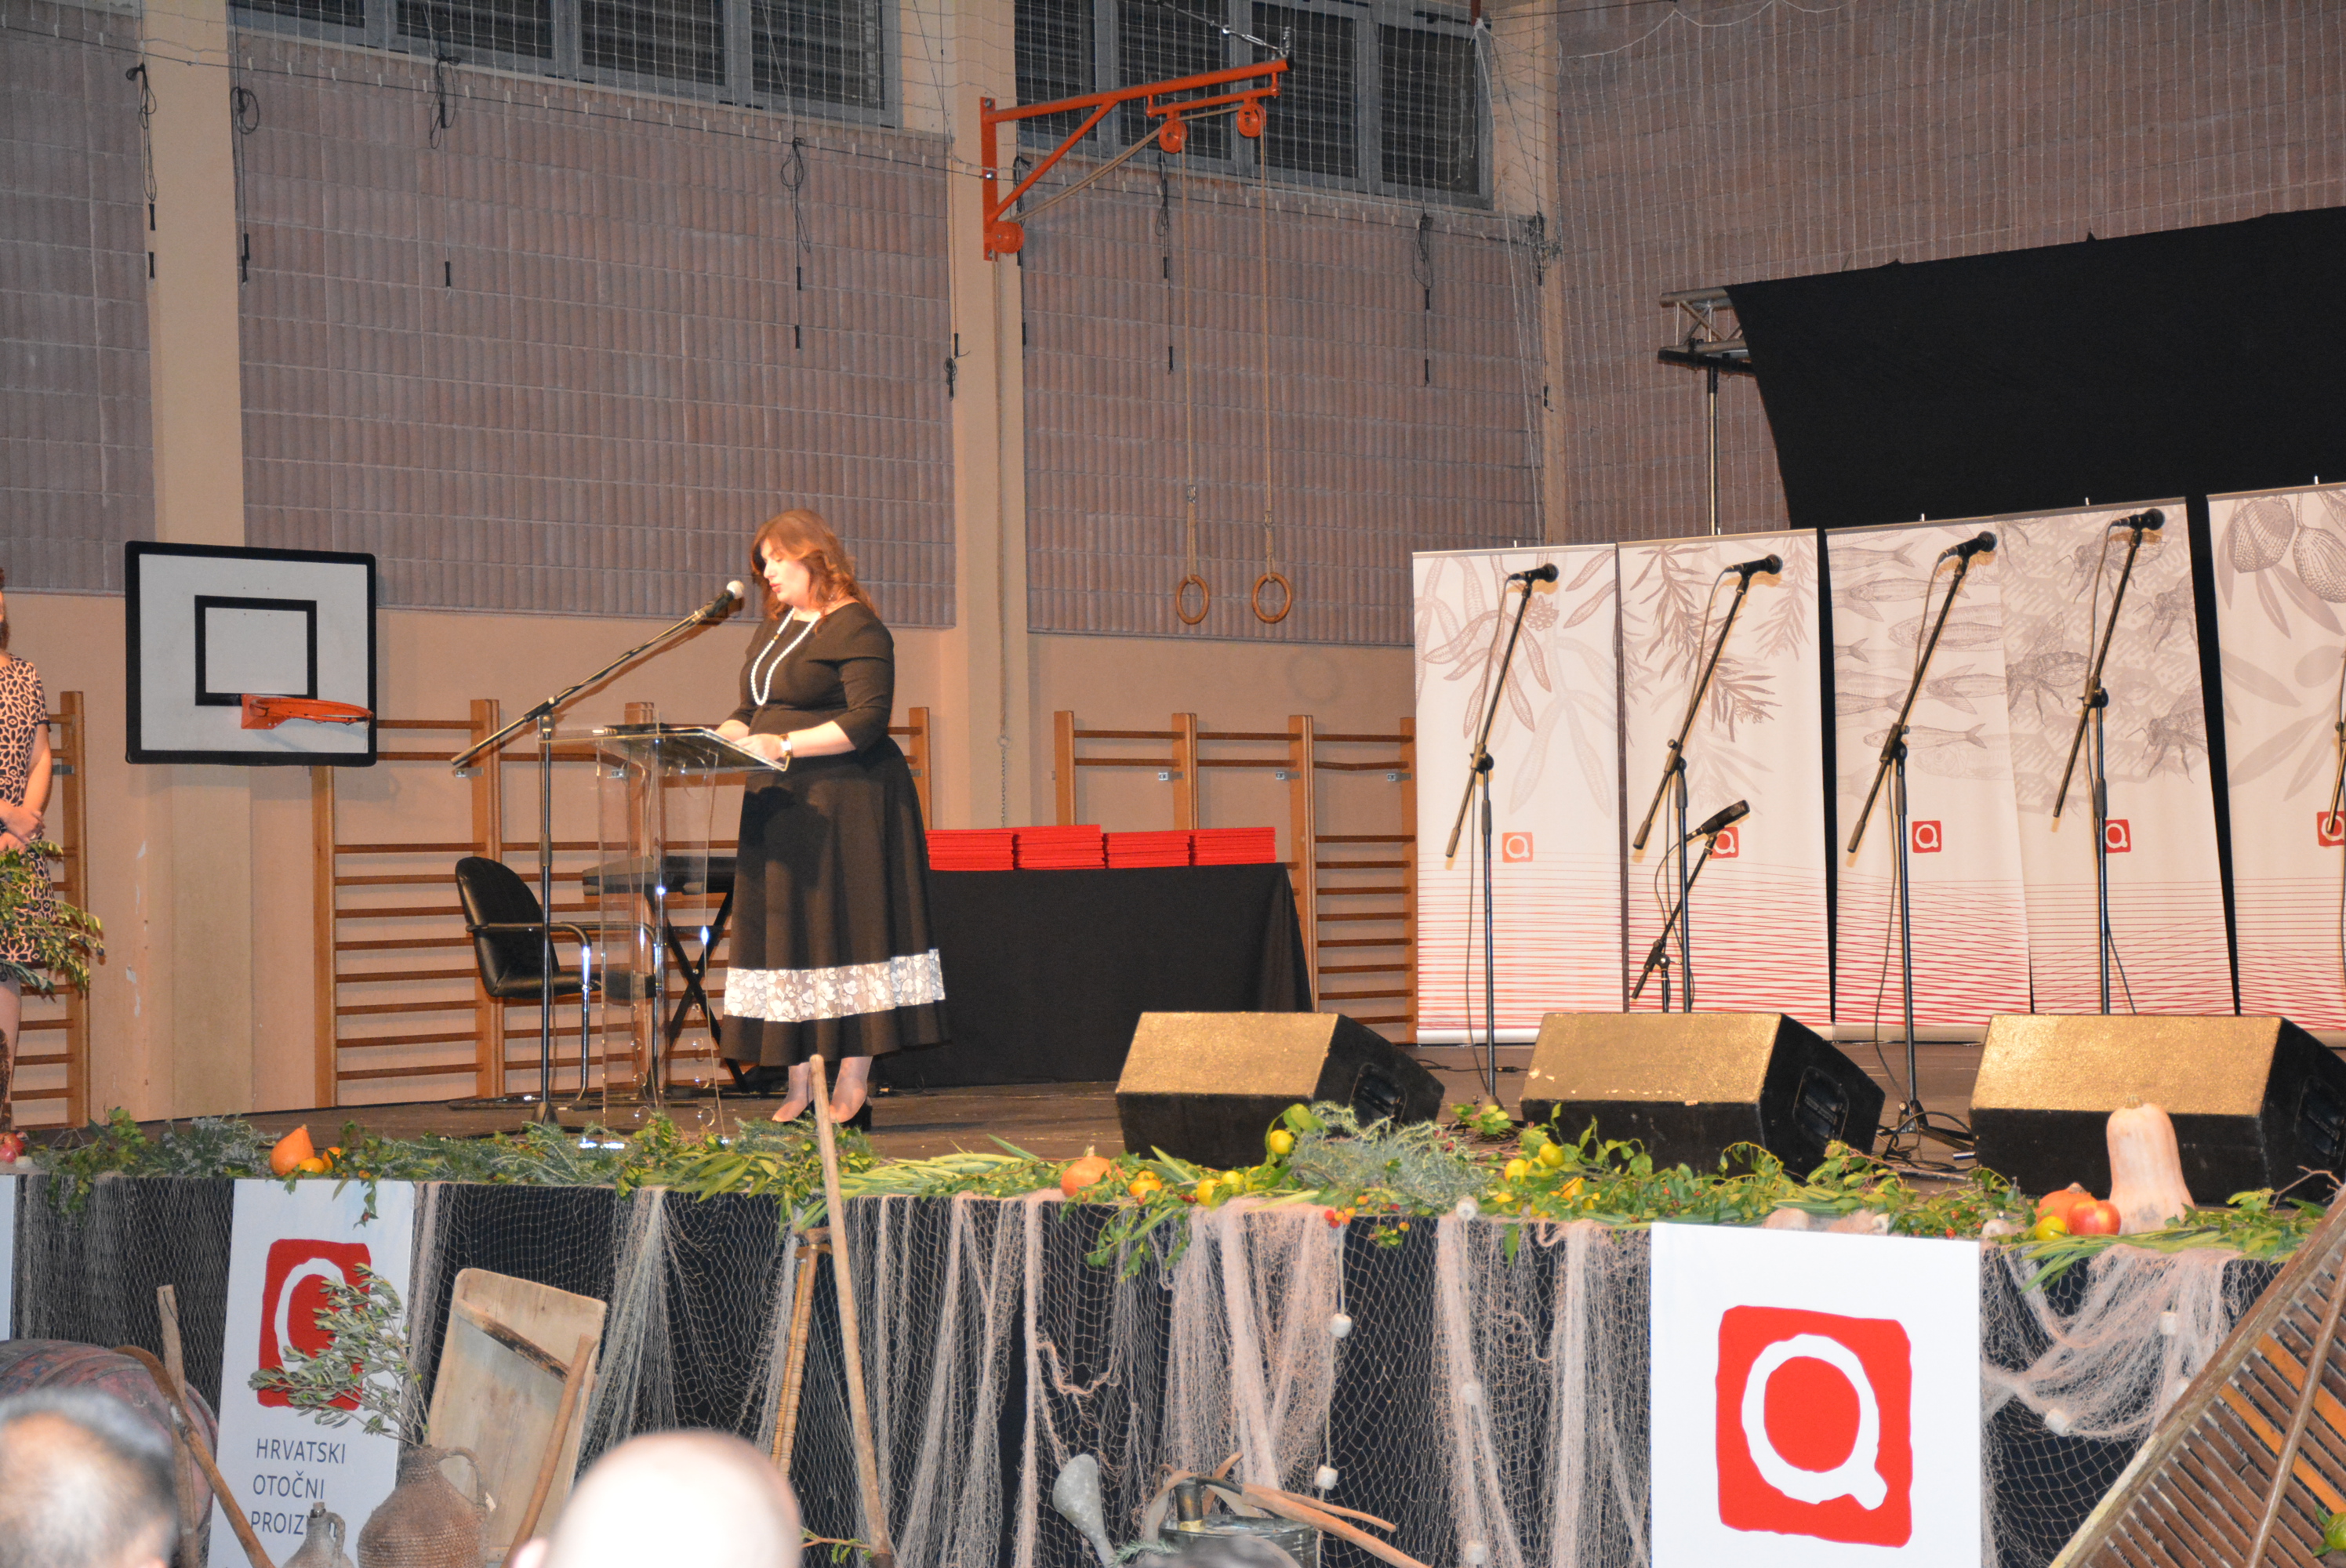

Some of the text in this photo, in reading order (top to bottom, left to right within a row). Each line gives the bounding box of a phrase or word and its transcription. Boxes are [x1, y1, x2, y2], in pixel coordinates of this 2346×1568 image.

[1505, 835, 1530, 858] Q
[1714, 830, 1736, 855] Q
[1915, 824, 1938, 848] Q
[2105, 823, 2128, 848] Q
[1741, 1333, 1888, 1511] Q
[256, 1438, 346, 1464] HRVATSKI
[252, 1470, 324, 1499] OTOČNI
